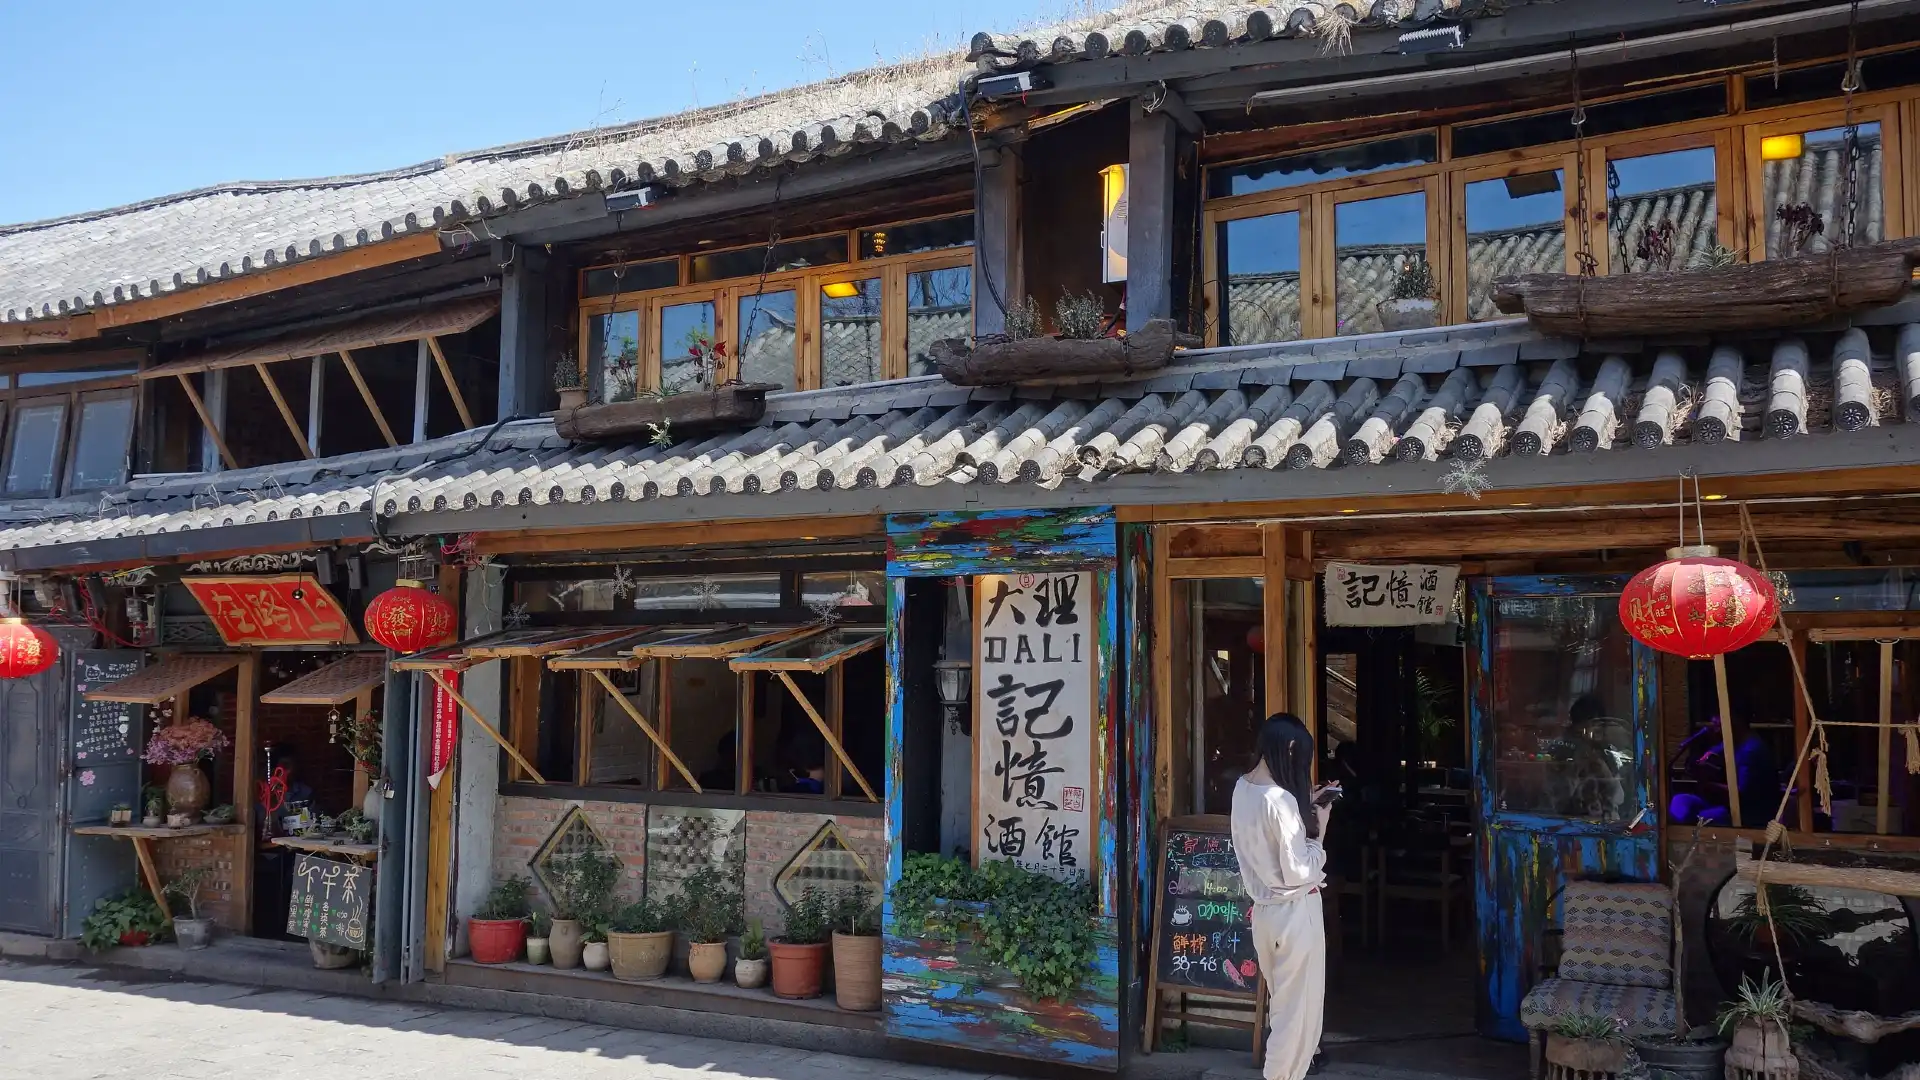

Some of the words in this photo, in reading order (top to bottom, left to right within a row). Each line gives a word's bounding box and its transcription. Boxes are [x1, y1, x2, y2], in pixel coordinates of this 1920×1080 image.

[985, 574, 1079, 628] 大理
[984, 633, 1082, 664] DALI
[986, 814, 1080, 867] 酒館
[298, 861, 359, 904] 下午茶
